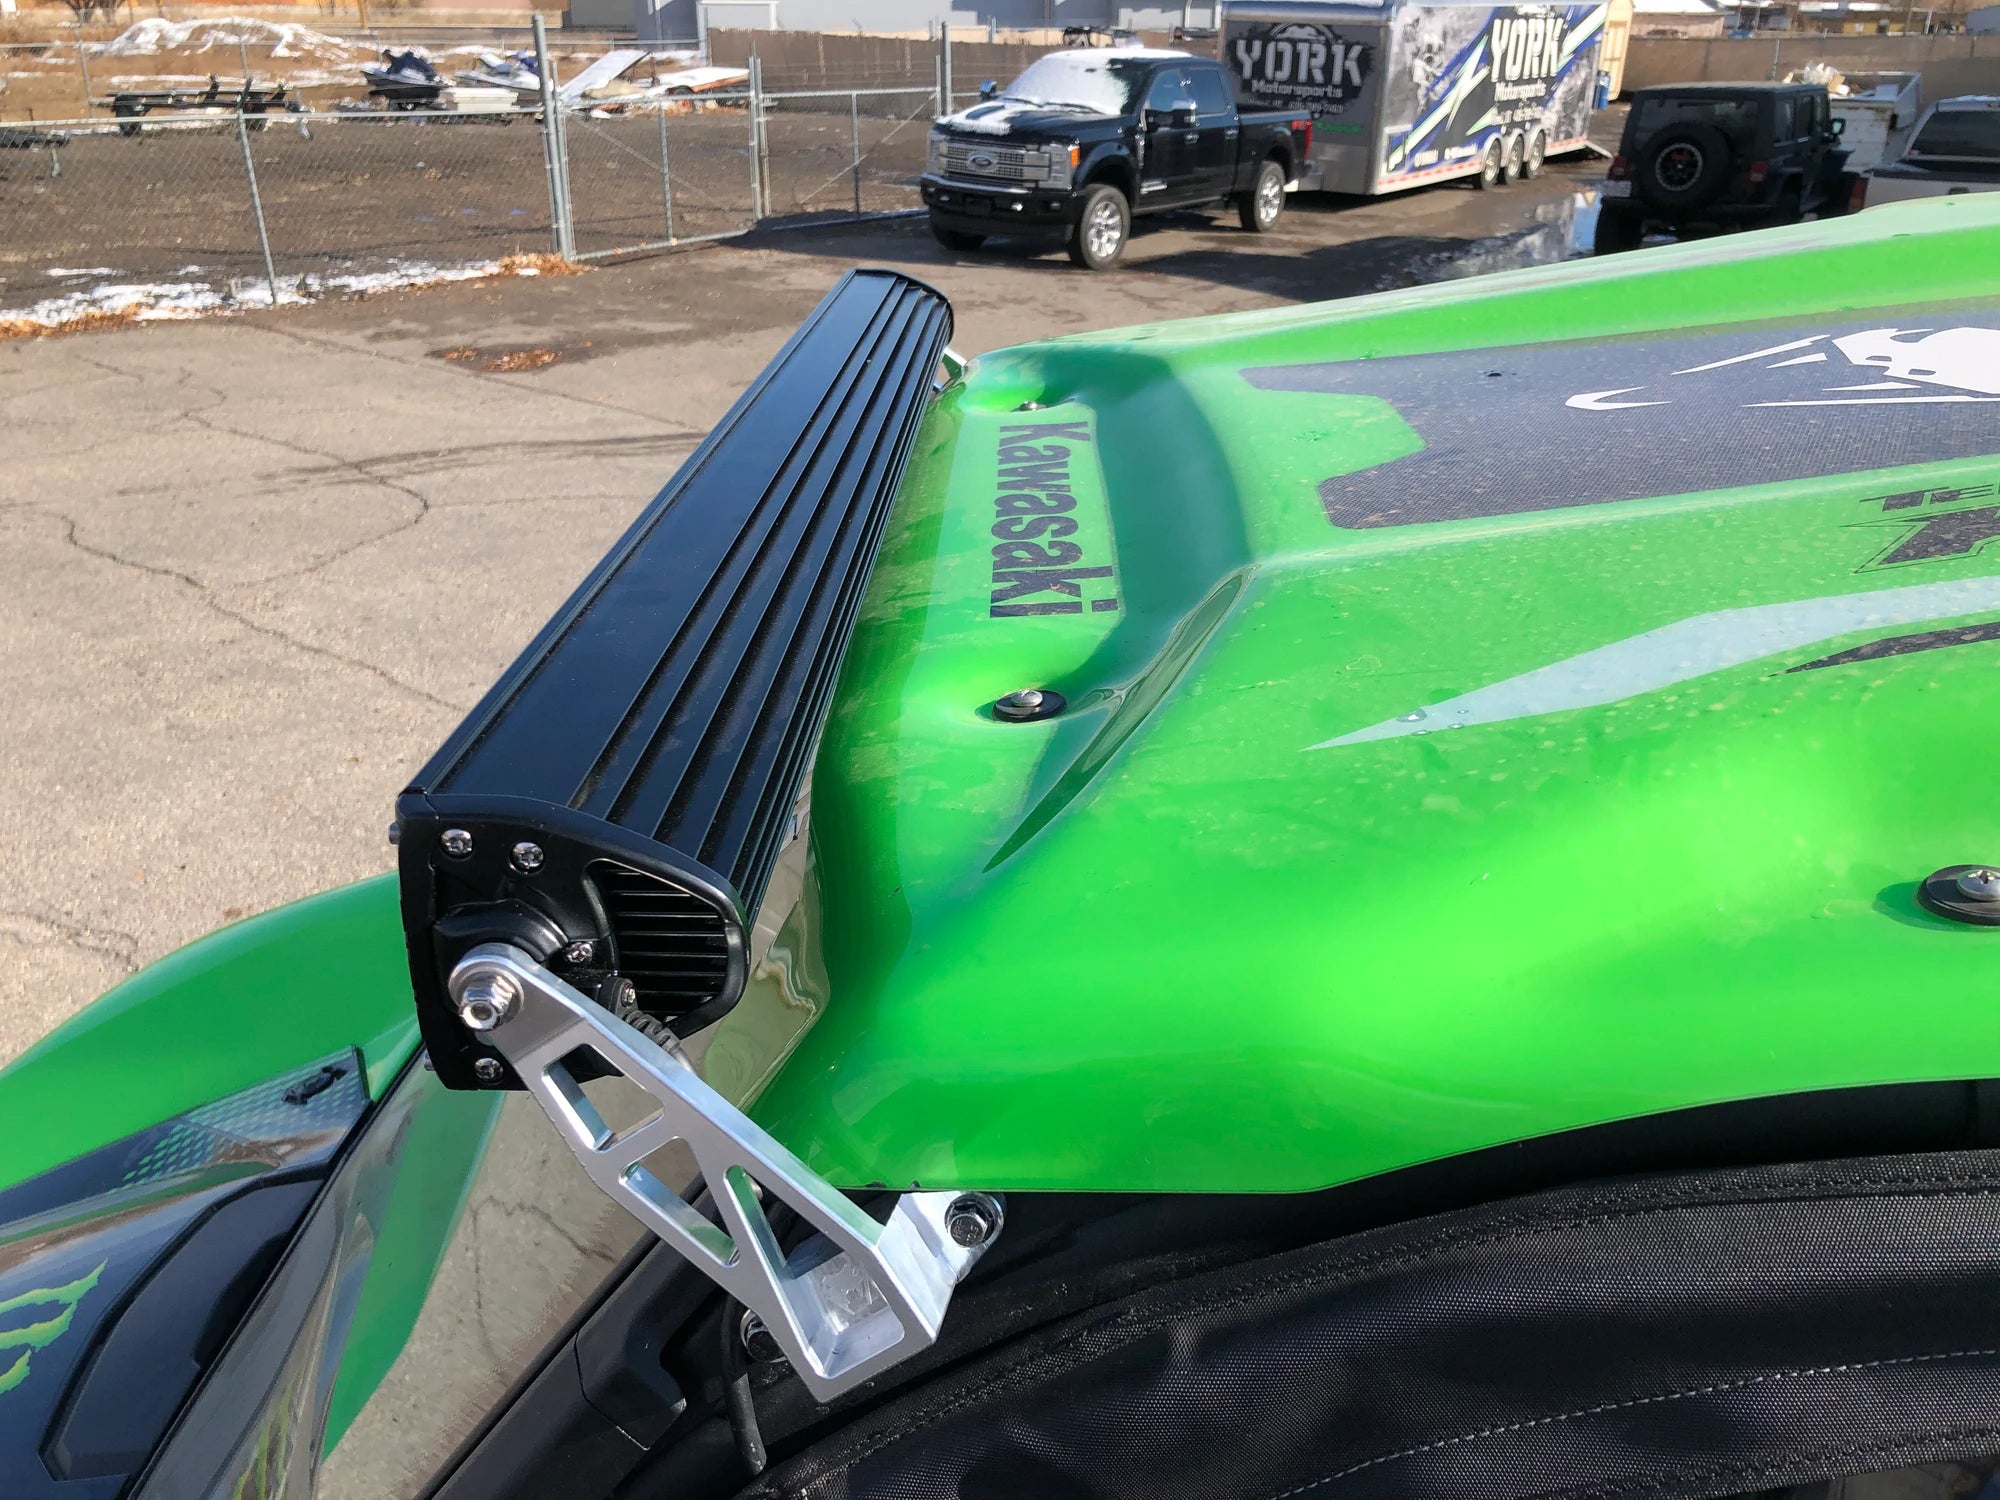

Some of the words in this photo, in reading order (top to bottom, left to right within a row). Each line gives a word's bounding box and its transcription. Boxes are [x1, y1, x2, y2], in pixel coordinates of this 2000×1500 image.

[1236, 40, 1363, 86] YORK
[1491, 18, 1564, 82] YORK
[1251, 80, 1343, 98] Motorsports
[990, 421, 1118, 618] Kawasaki
